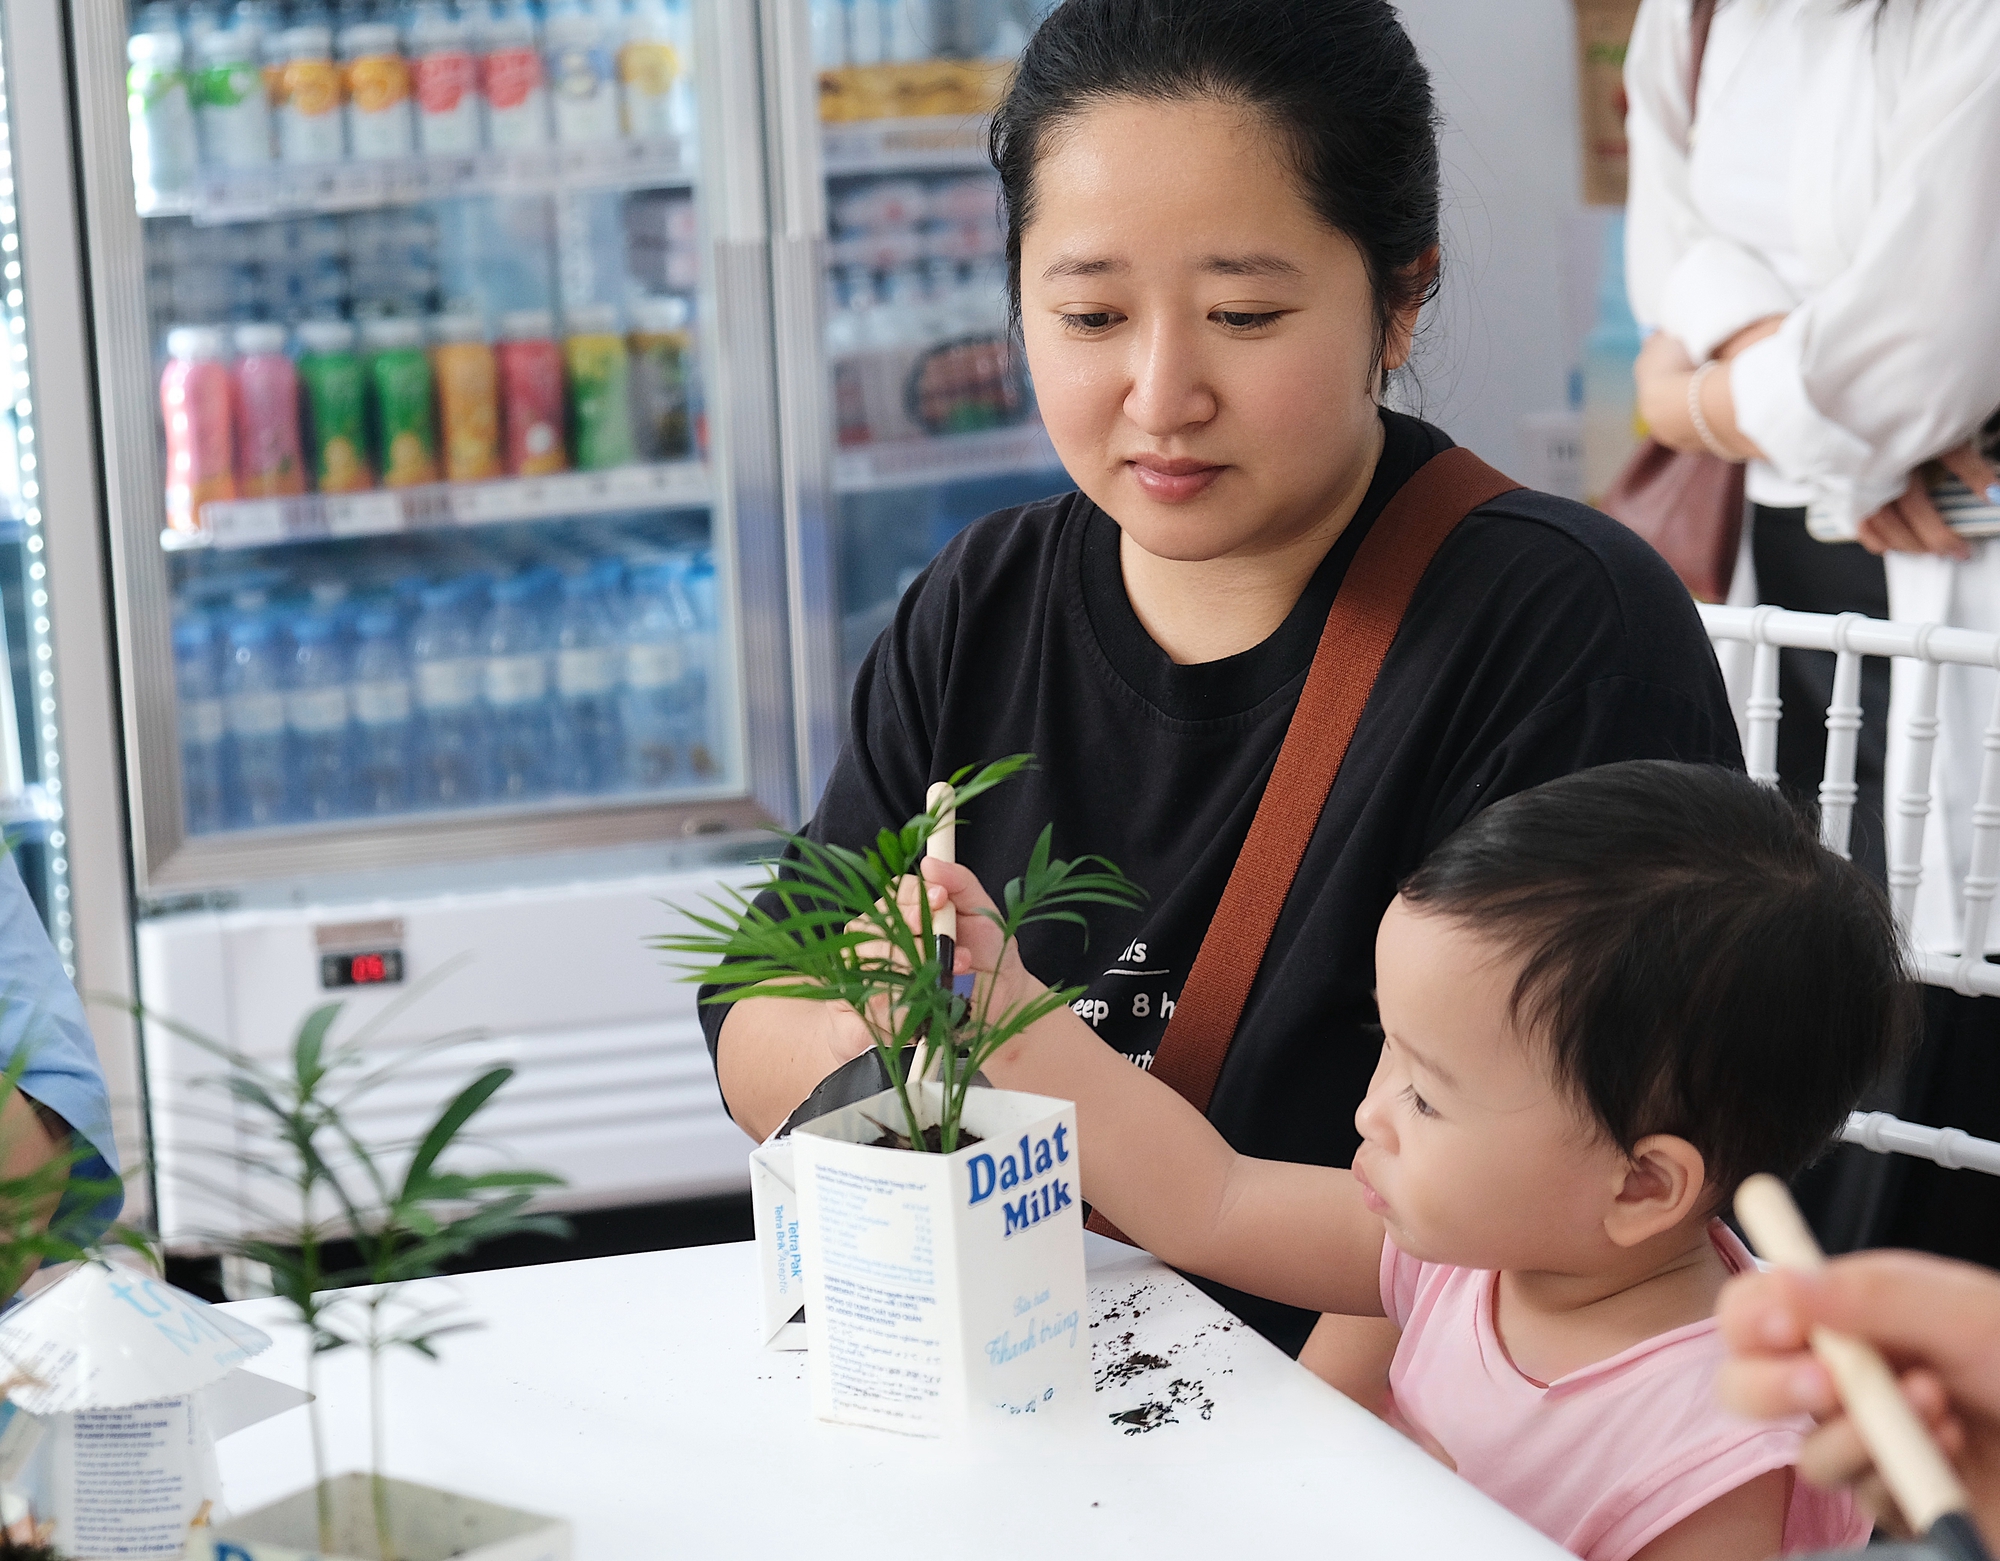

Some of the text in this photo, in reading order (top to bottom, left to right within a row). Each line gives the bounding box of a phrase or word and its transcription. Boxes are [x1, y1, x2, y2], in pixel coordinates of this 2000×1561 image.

[1067, 998, 1109, 1027] eep
[1132, 993, 1150, 1018] 8
[966, 1121, 1069, 1208] Dalat
[774, 1204, 784, 1229] Tetra
[1003, 1178, 1072, 1240] Milk
[787, 1220, 800, 1251] Tetra
[777, 1253, 787, 1294] Aseptic
